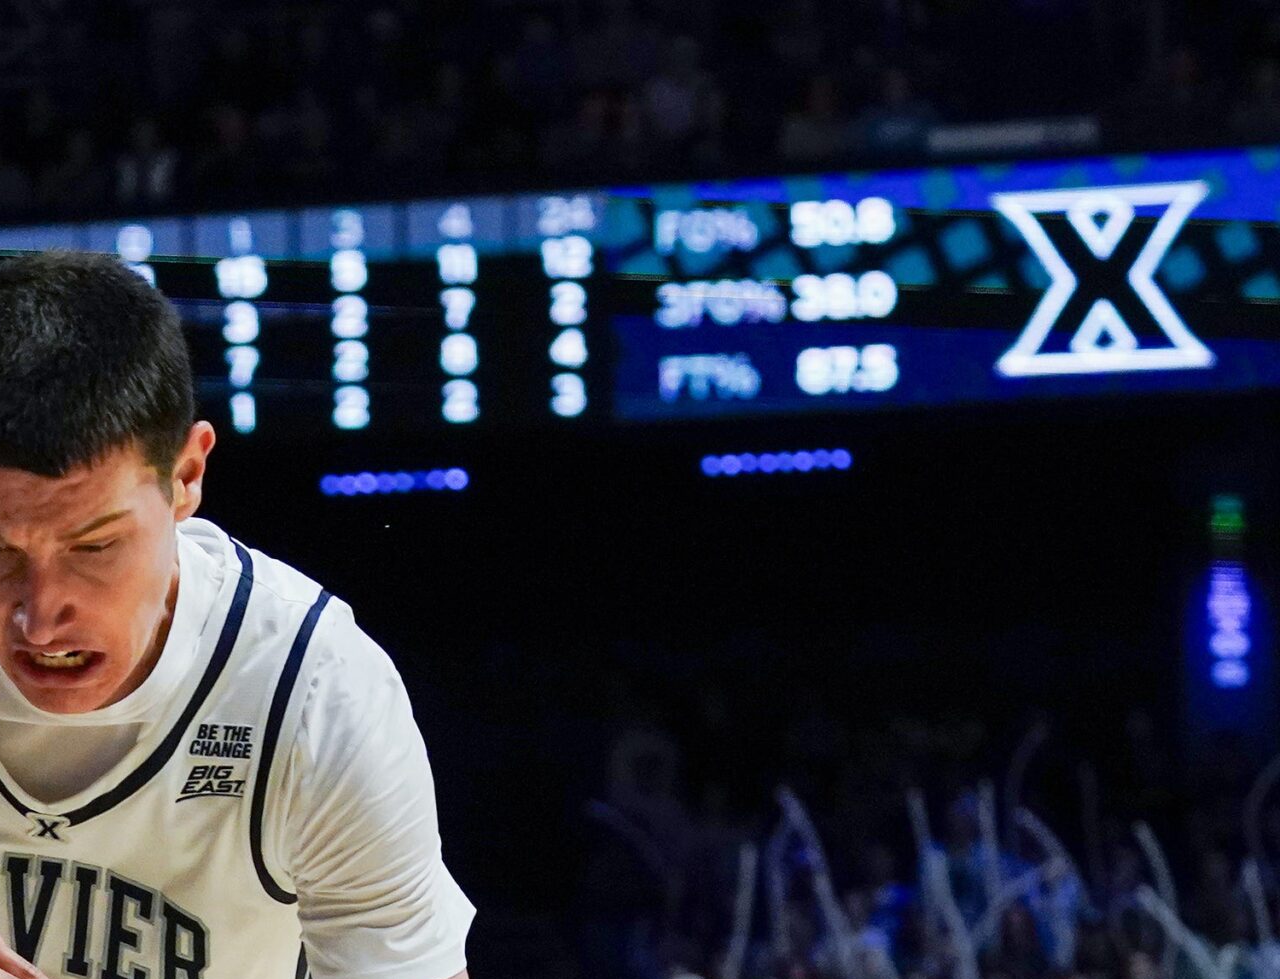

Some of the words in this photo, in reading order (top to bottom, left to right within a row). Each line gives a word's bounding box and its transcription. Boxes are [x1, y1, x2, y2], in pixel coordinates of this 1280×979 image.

[197, 723, 219, 740] BE
[223, 725, 253, 742] THE
[189, 740, 253, 759] CHANGE
[187, 765, 234, 780] BIG
[32, 818, 64, 842] X
